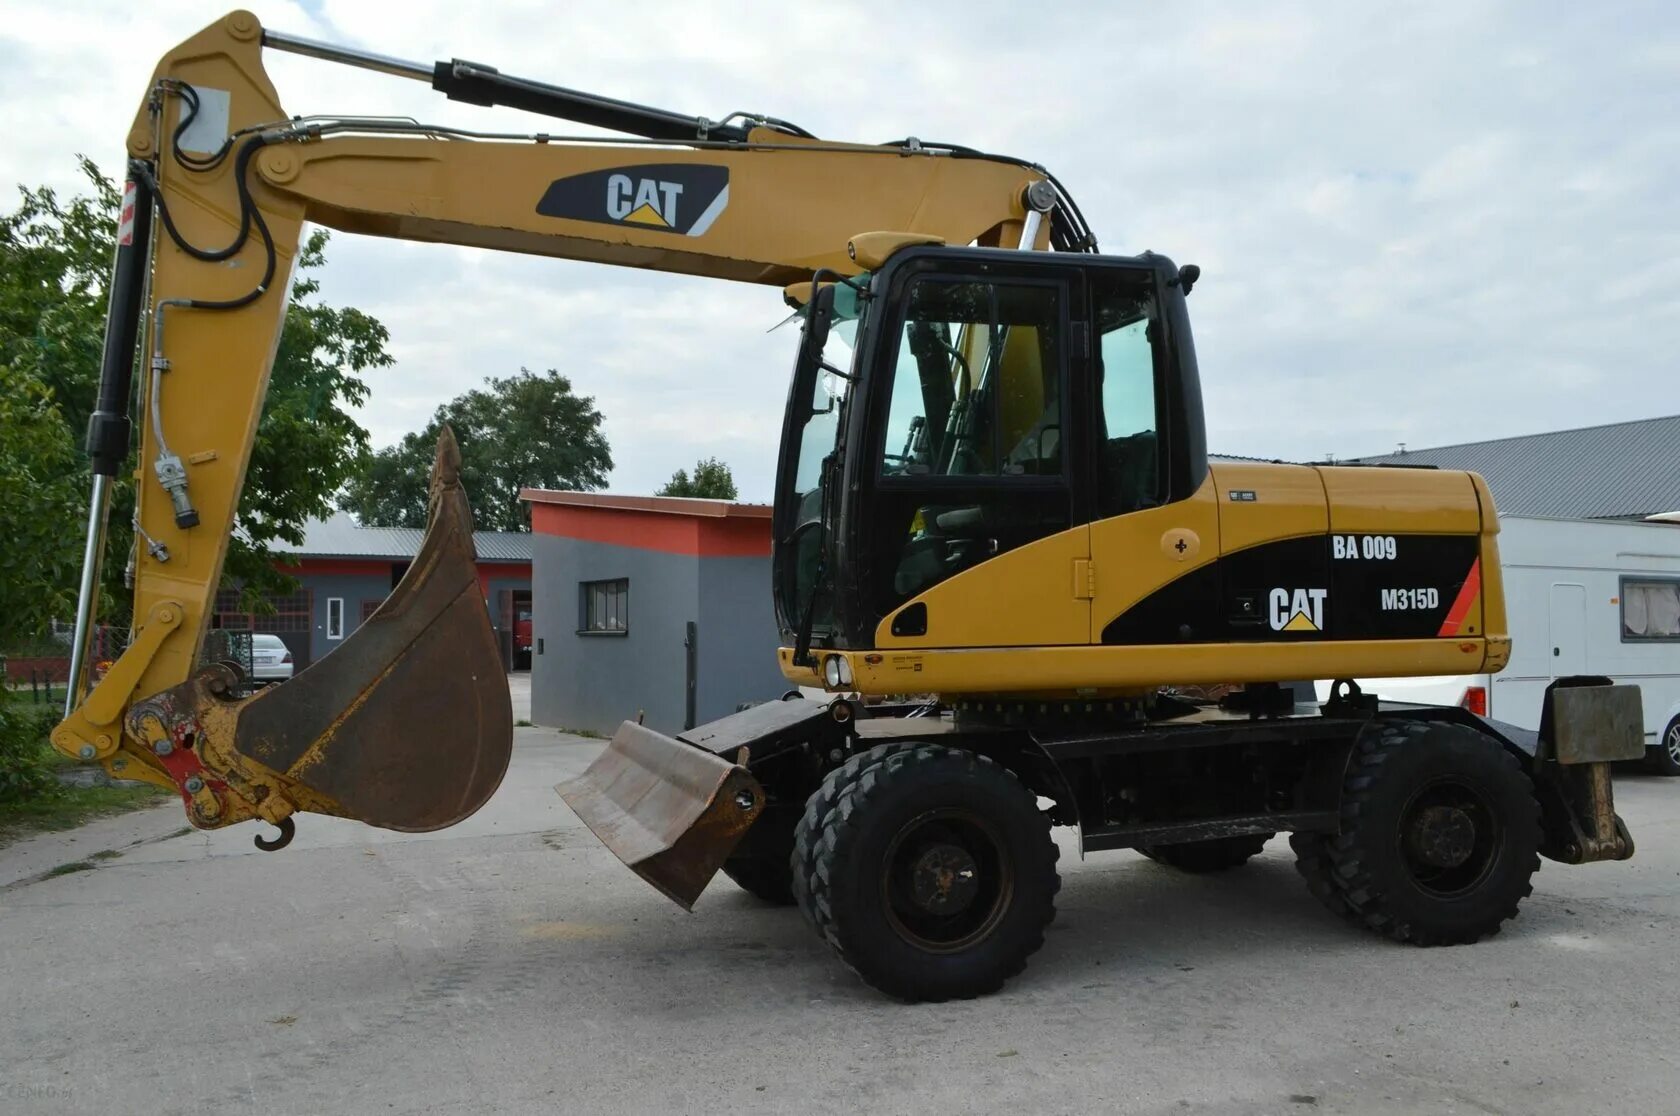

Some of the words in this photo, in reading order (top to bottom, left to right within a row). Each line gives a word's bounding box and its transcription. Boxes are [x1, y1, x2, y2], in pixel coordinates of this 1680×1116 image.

[606, 174, 684, 228] CAT
[1332, 535, 1359, 559] BA
[1362, 536, 1397, 560] 009
[1269, 588, 1328, 631] CAT
[1381, 588, 1439, 611] M315D
